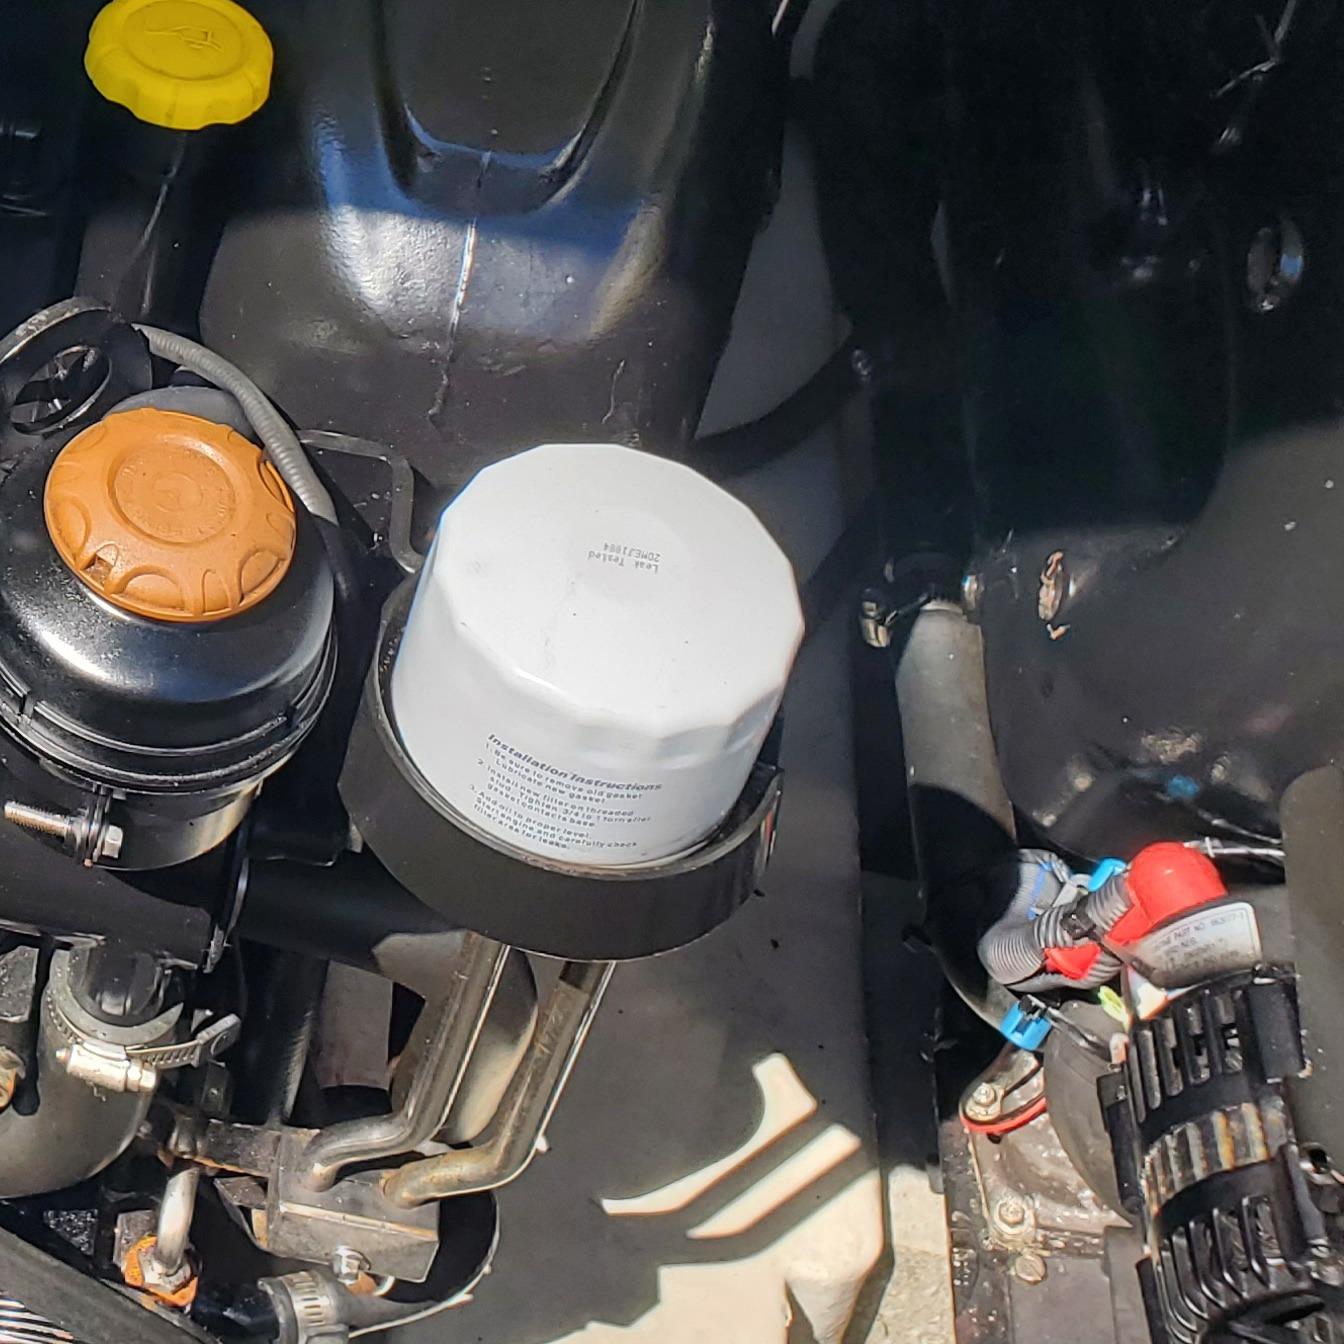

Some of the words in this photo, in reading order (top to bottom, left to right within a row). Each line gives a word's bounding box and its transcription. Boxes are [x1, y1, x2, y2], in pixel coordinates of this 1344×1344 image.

[488, 734, 568, 779] Installation
[570, 774, 662, 791] Instructions
[494, 749, 506, 760] Be
[509, 759, 531, 773] sure
[533, 770, 543, 779] to
[545, 776, 584, 792] remove
[587, 789, 604, 797] old
[496, 758, 543, 786] Lubricate
[545, 784, 565, 794] new
[487, 765, 519, 788] Install
[520, 785, 541, 797] new
[543, 794, 569, 807] filter
[586, 807, 634, 816] threaded
[487, 783, 520, 804] gasket
[521, 801, 567, 822] contacts
[519, 791, 558, 812] Tighten
[562, 808, 579, 817] 3/4
[474, 803, 497, 821] filter
[477, 797, 500, 814] Start
[500, 813, 535, 831] engine
[537, 828, 556, 838] and
[558, 835, 605, 848] carefully
[479, 791, 498, 806] Add
[498, 804, 512, 814] oil
[525, 816, 561, 833] proper
